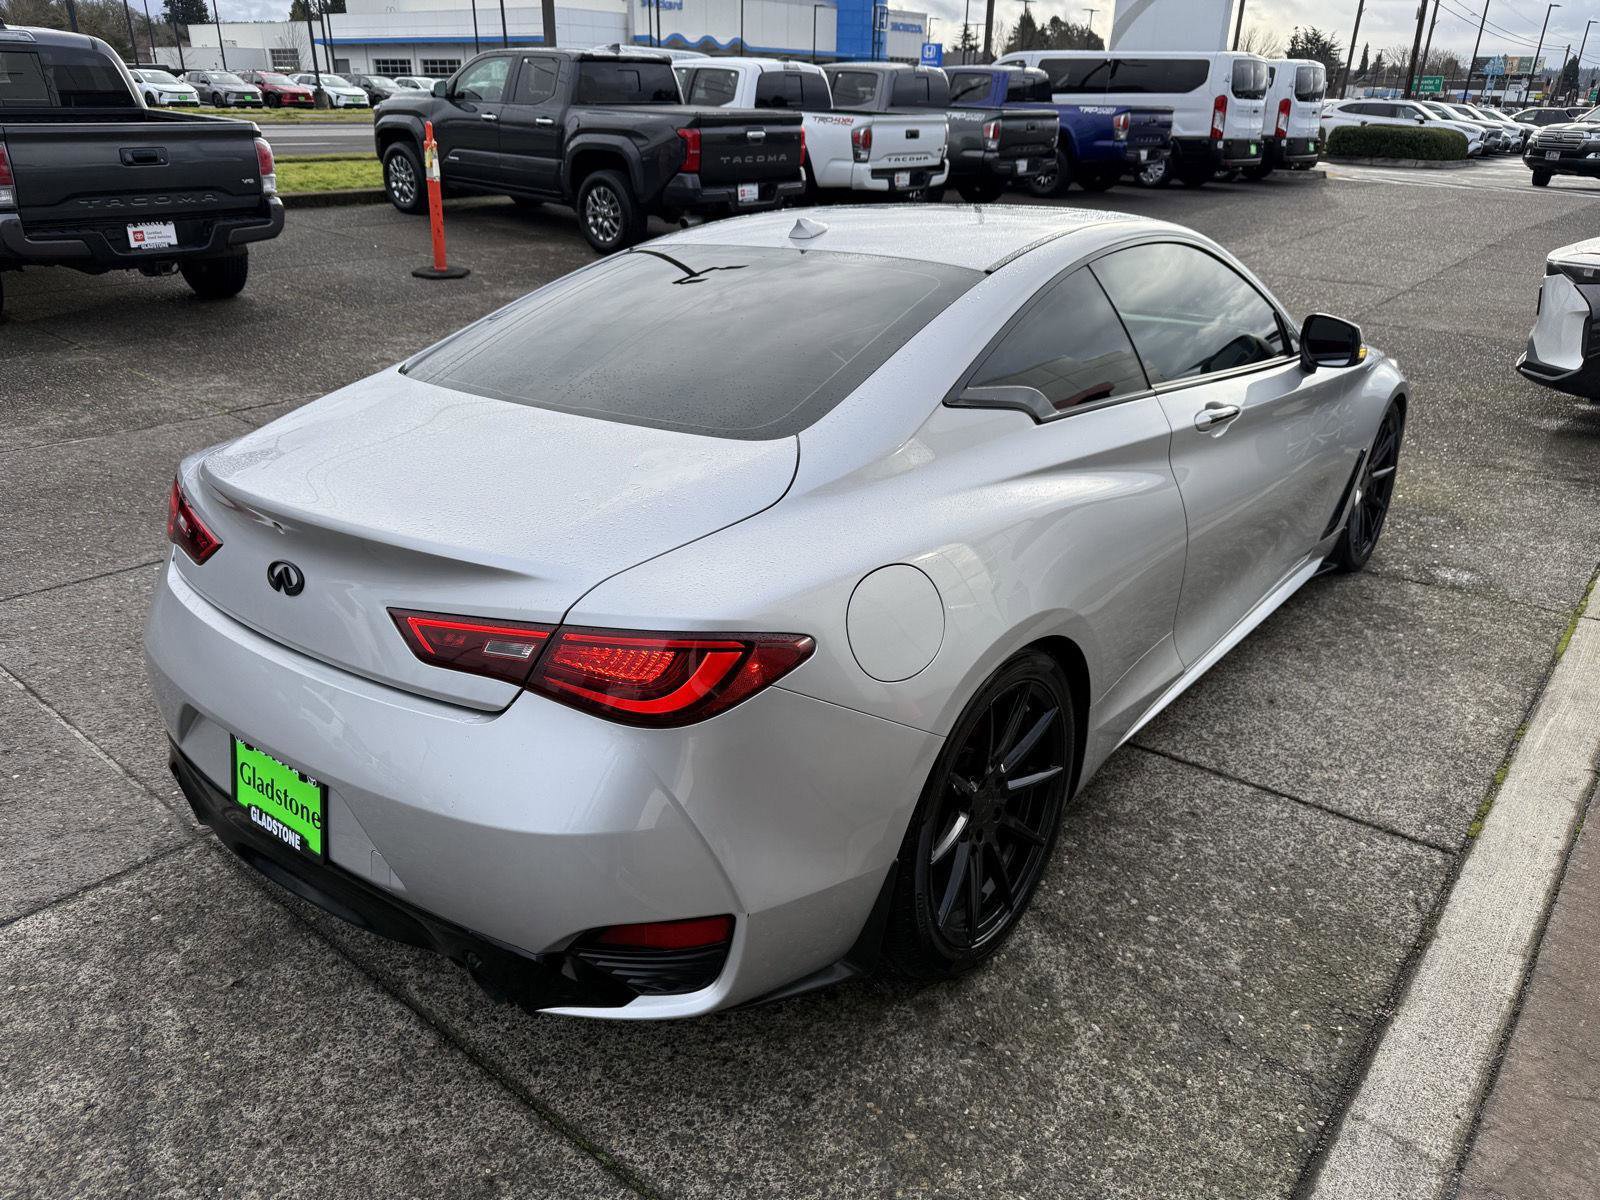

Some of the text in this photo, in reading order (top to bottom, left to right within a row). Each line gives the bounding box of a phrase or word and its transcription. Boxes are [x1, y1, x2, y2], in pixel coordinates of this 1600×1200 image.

[720, 153, 788, 164] TACOMA
[78, 194, 219, 209] TACOMA
[240, 761, 321, 830] Gladstone
[250, 805, 301, 851] GLADSTONE
